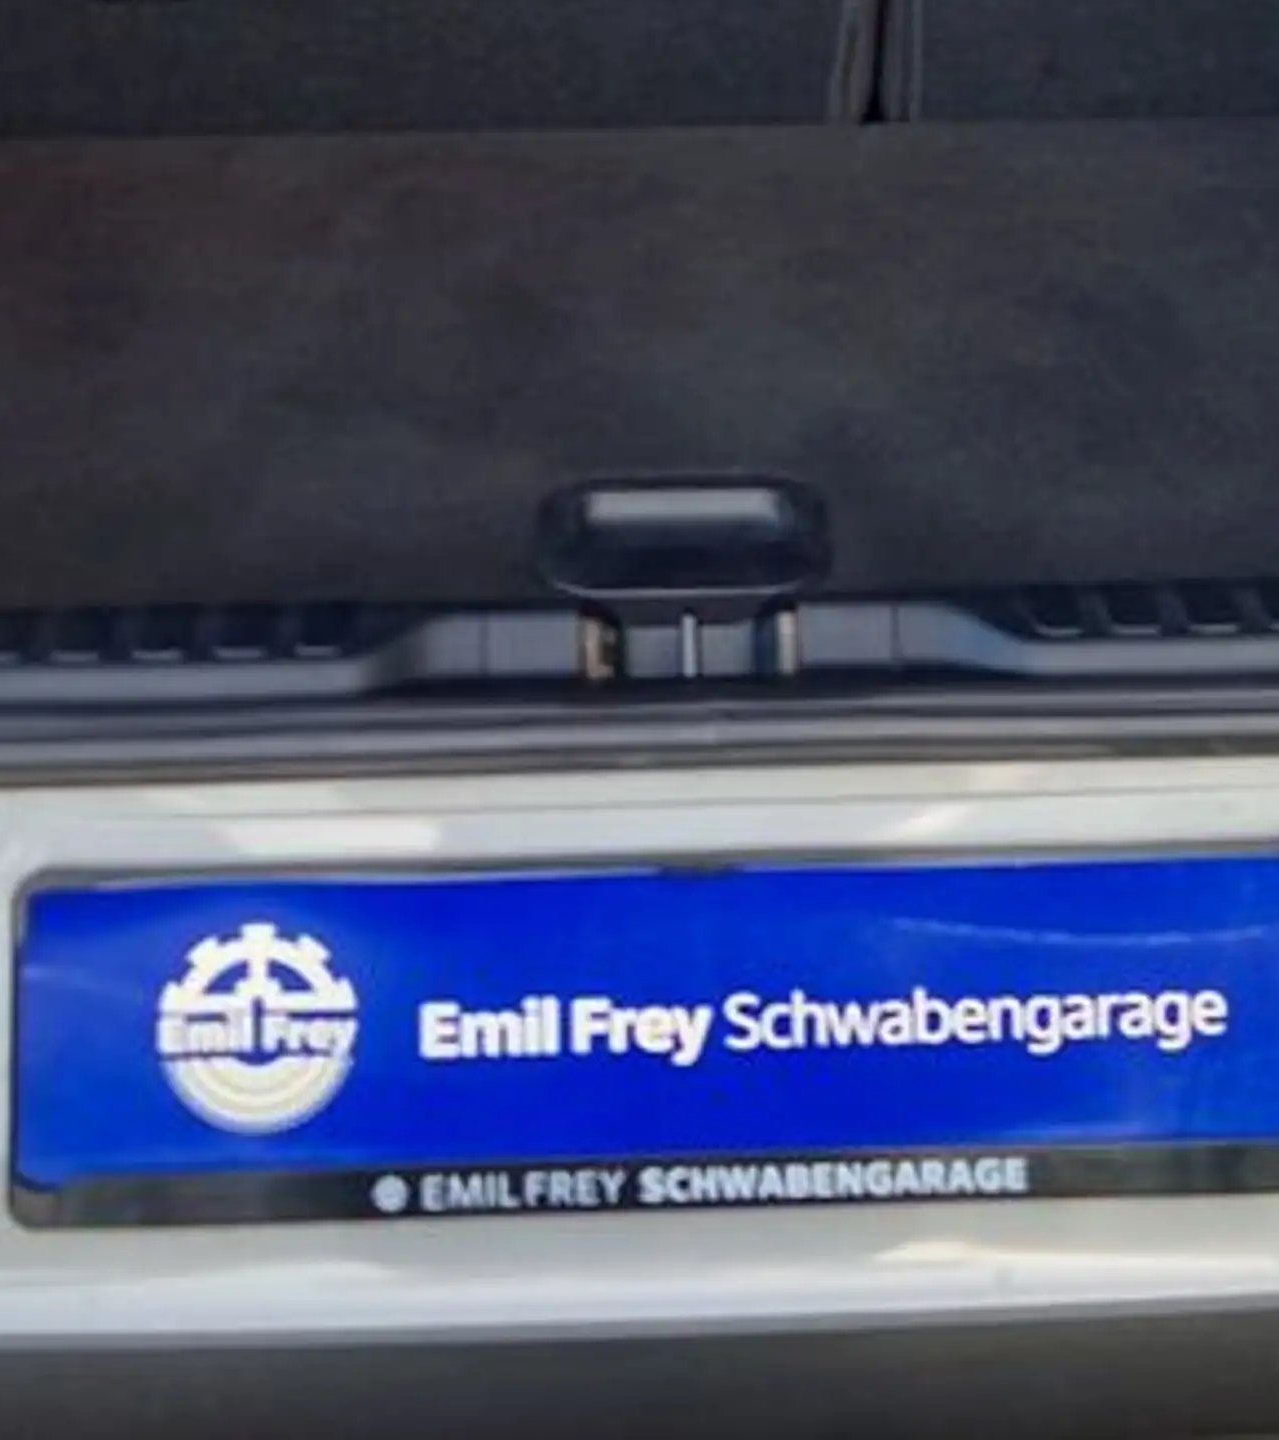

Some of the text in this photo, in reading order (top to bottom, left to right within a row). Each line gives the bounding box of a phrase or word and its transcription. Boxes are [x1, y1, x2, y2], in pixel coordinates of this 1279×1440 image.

[419, 986, 1229, 1067] Emil Frey Schwabengarage
[421, 1157, 1029, 1211] EMIL FREY SCHWABENGARAGE
